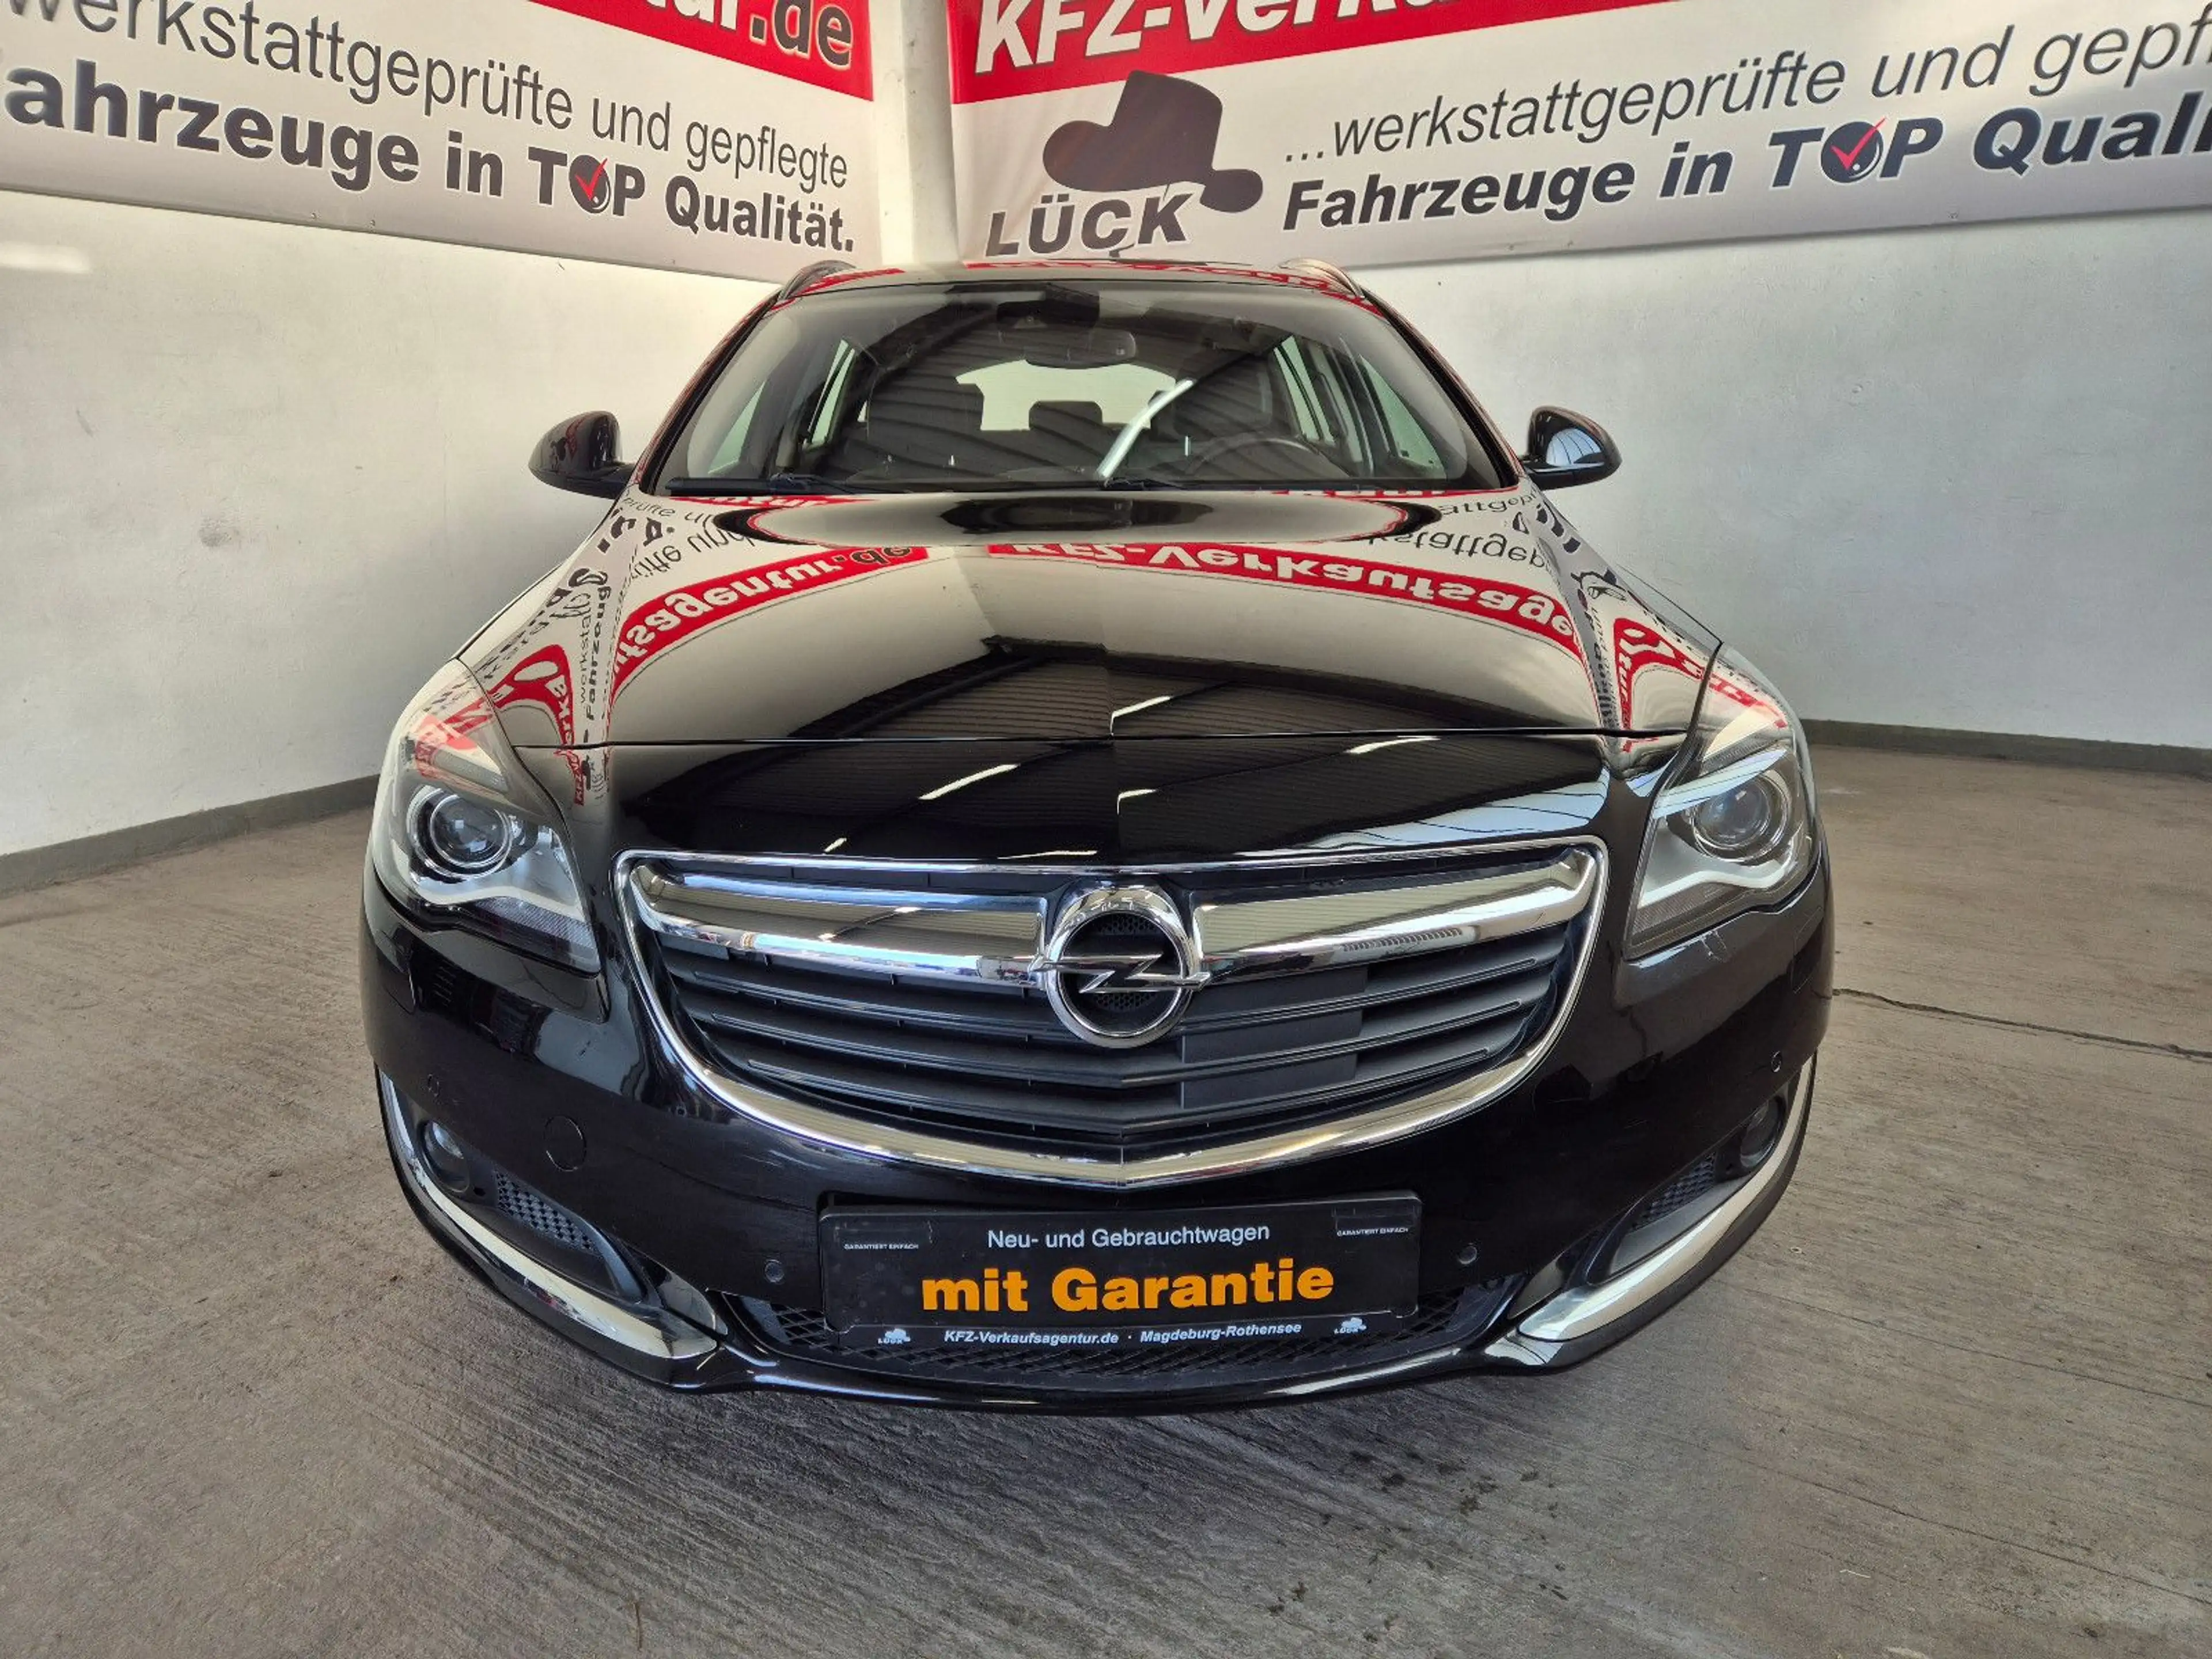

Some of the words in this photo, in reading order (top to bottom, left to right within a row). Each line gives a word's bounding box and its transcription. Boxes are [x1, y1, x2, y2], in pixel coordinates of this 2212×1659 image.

[975, 0, 1434, 75] KFZ-Ve
[1871, 24, 2016, 99] und
[2029, 1, 2212, 97] gepf
[0, 59, 419, 191] ahrzeuge
[446, 131, 504, 197] in
[666, 175, 854, 252] Qualität.
[592, 98, 671, 151] und
[685, 121, 848, 194] gepflegte
[1283, 162, 1635, 230] Fahrzeuge
[1660, 140, 1733, 198] in
[985, 190, 1192, 257] LÜCK
[987, 1230, 1039, 1249] Neu-
[1046, 1229, 1085, 1248] und
[1092, 1225, 1270, 1248] Gebrauchtwagen
[922, 1267, 1029, 1312] mit
[1051, 1257, 1335, 1312] Garantie
[944, 1330, 1119, 1346] KFZ-Verkaufsagentur.de
[1140, 1323, 1302, 1344] Magdeburg-Rothensee
